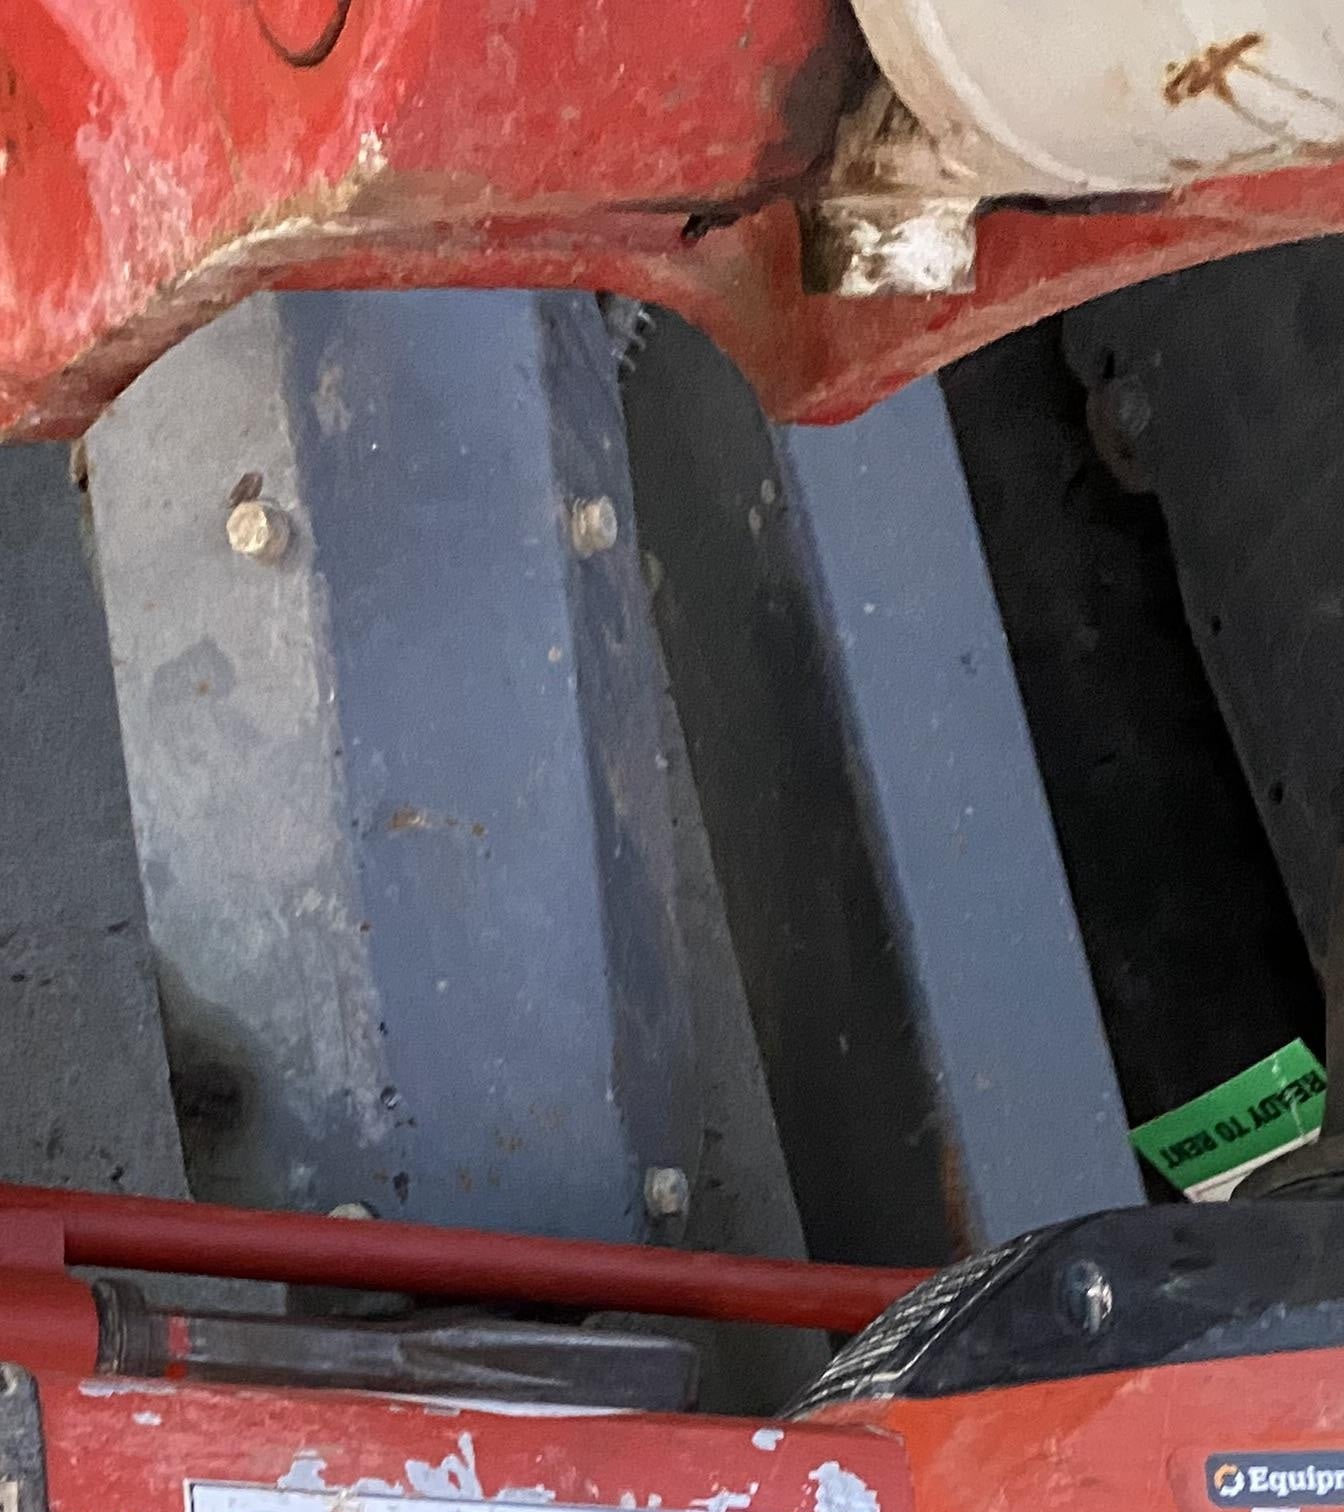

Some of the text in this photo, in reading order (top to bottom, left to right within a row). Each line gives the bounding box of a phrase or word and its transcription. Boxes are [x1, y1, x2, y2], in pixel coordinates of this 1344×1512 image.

[1159, 1069, 1328, 1169] READY TO RENT
